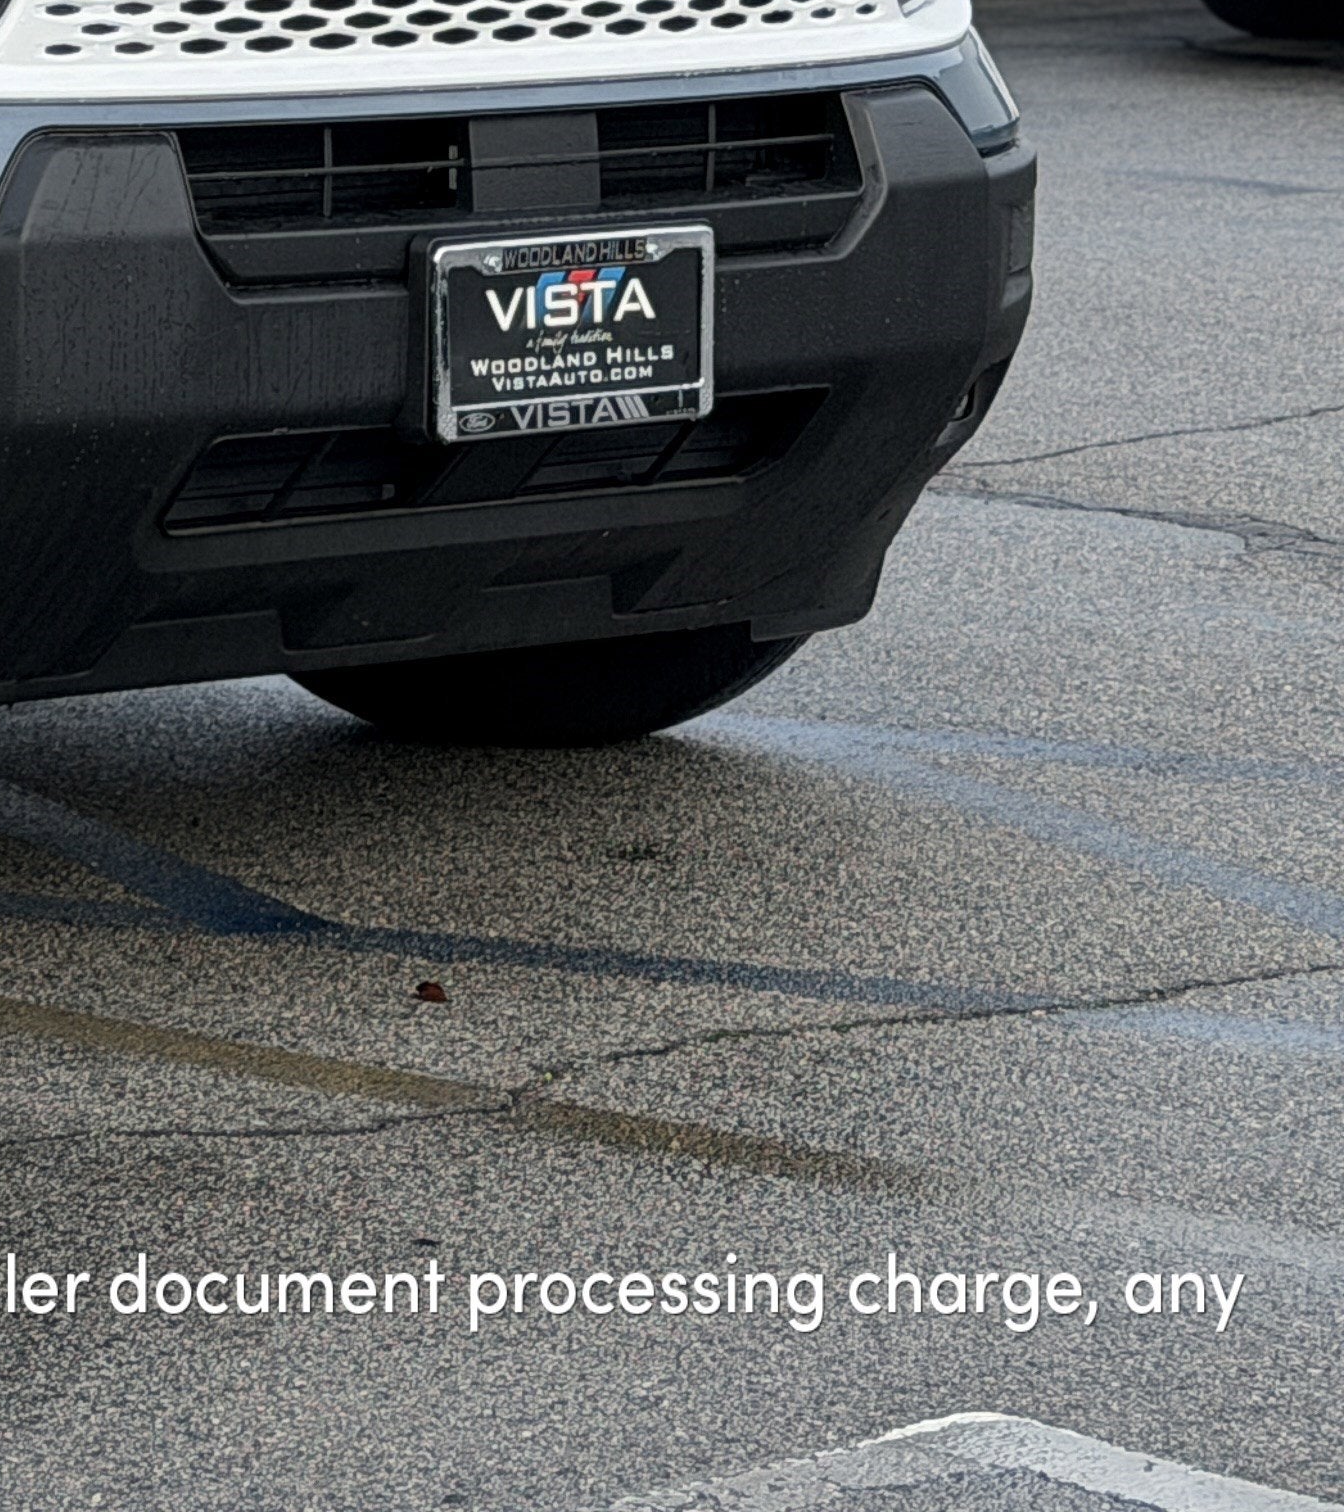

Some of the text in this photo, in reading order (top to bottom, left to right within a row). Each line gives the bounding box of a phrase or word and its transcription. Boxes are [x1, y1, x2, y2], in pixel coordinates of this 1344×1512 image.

[503, 238, 647, 269] WOODLAND HILLS
[485, 277, 657, 332] VISTA
[470, 344, 674, 377] WOODLAND HILLS
[510, 397, 617, 431] VISTA
